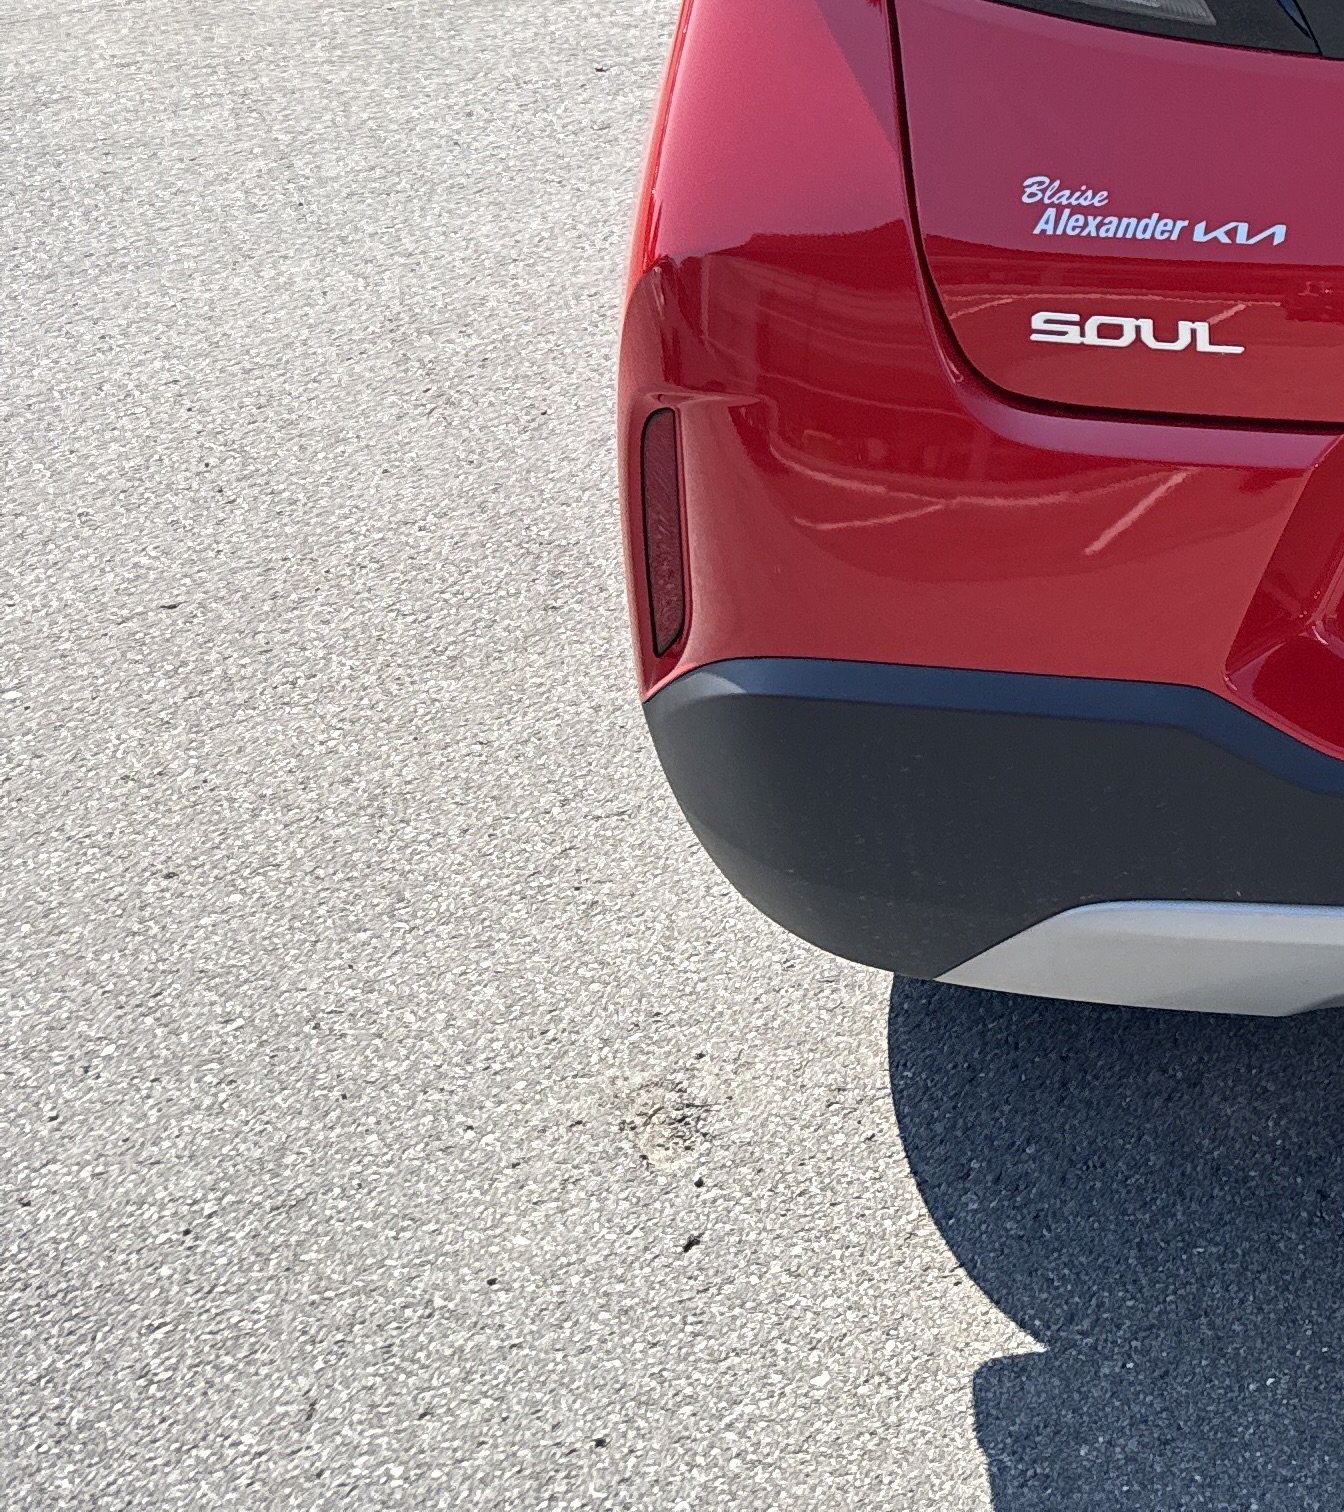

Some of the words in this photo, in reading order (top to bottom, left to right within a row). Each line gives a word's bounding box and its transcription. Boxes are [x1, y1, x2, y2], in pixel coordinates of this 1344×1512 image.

[1021, 176, 1109, 207] Blaise
[1033, 207, 1189, 241] Alexander
[1193, 221, 1287, 246] KIA
[1030, 311, 1245, 354] SOUL
